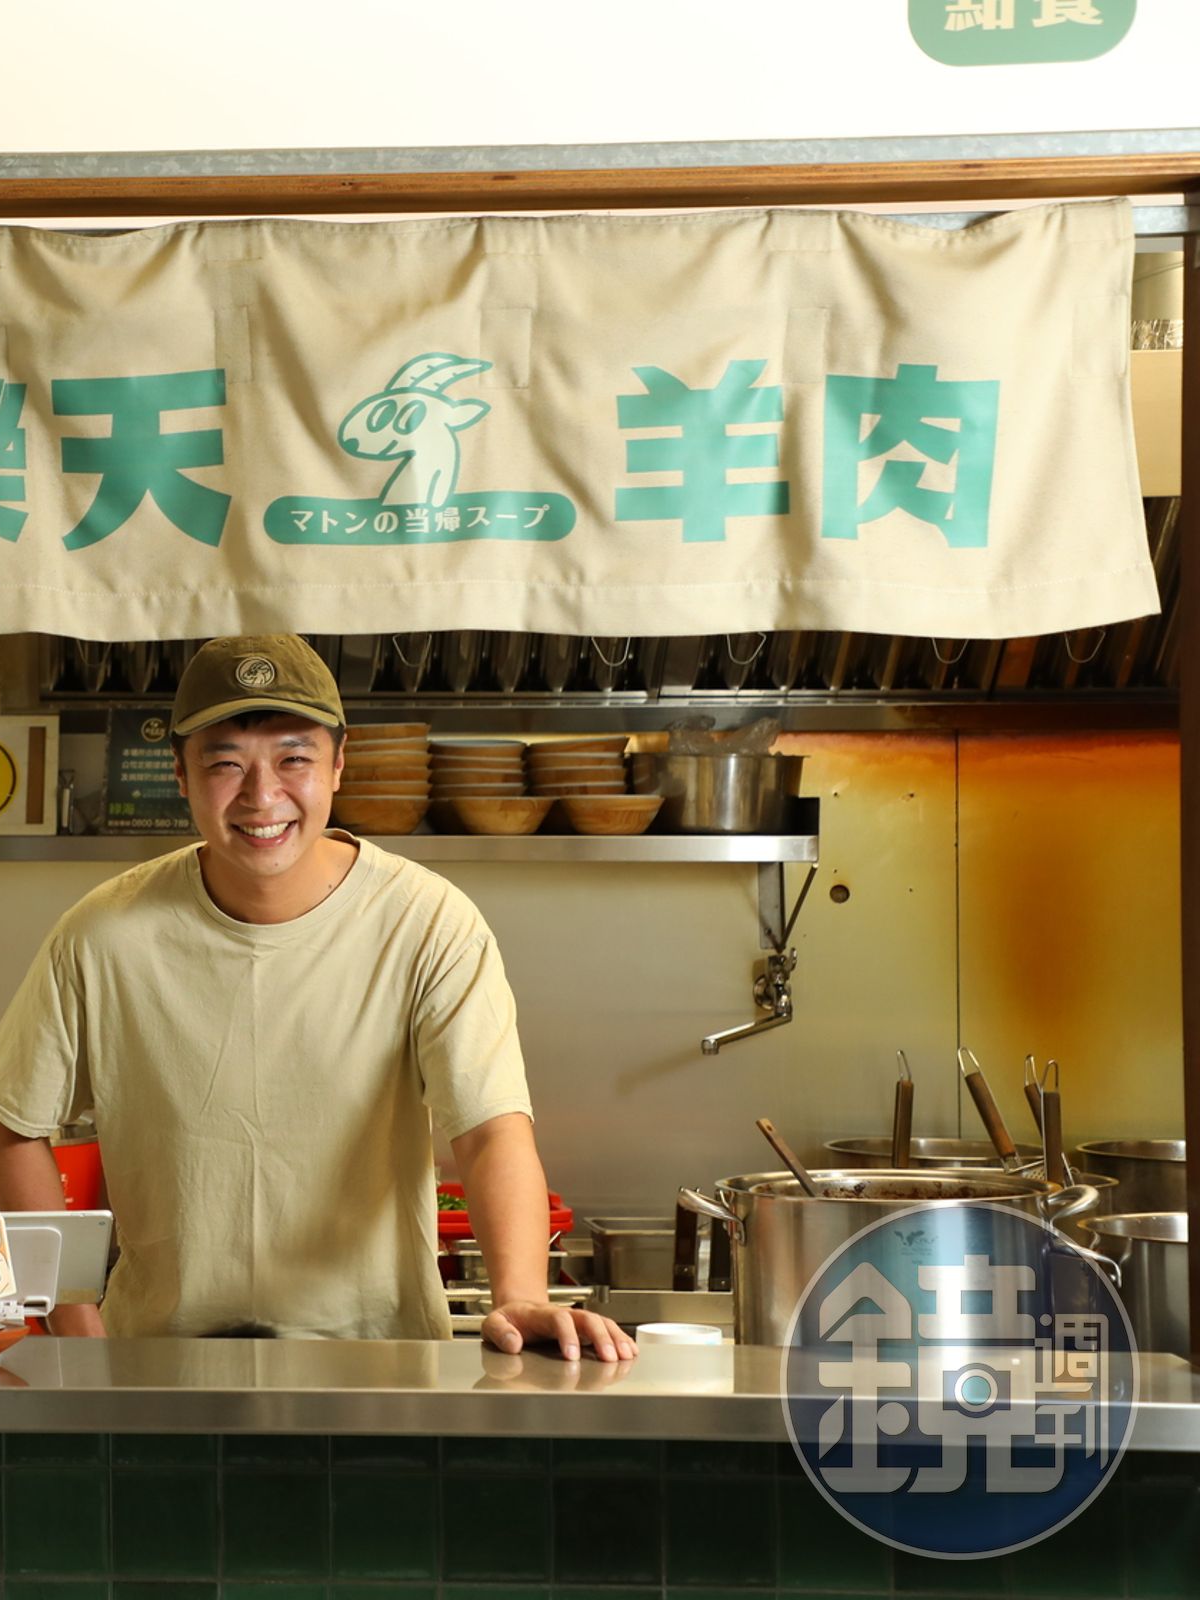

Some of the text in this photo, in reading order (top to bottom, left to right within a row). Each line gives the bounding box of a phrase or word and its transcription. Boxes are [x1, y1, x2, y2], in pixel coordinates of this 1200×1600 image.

[614, 359, 1000, 548] 羊肉
[290, 503, 550, 534] マトンの当帰スープ
